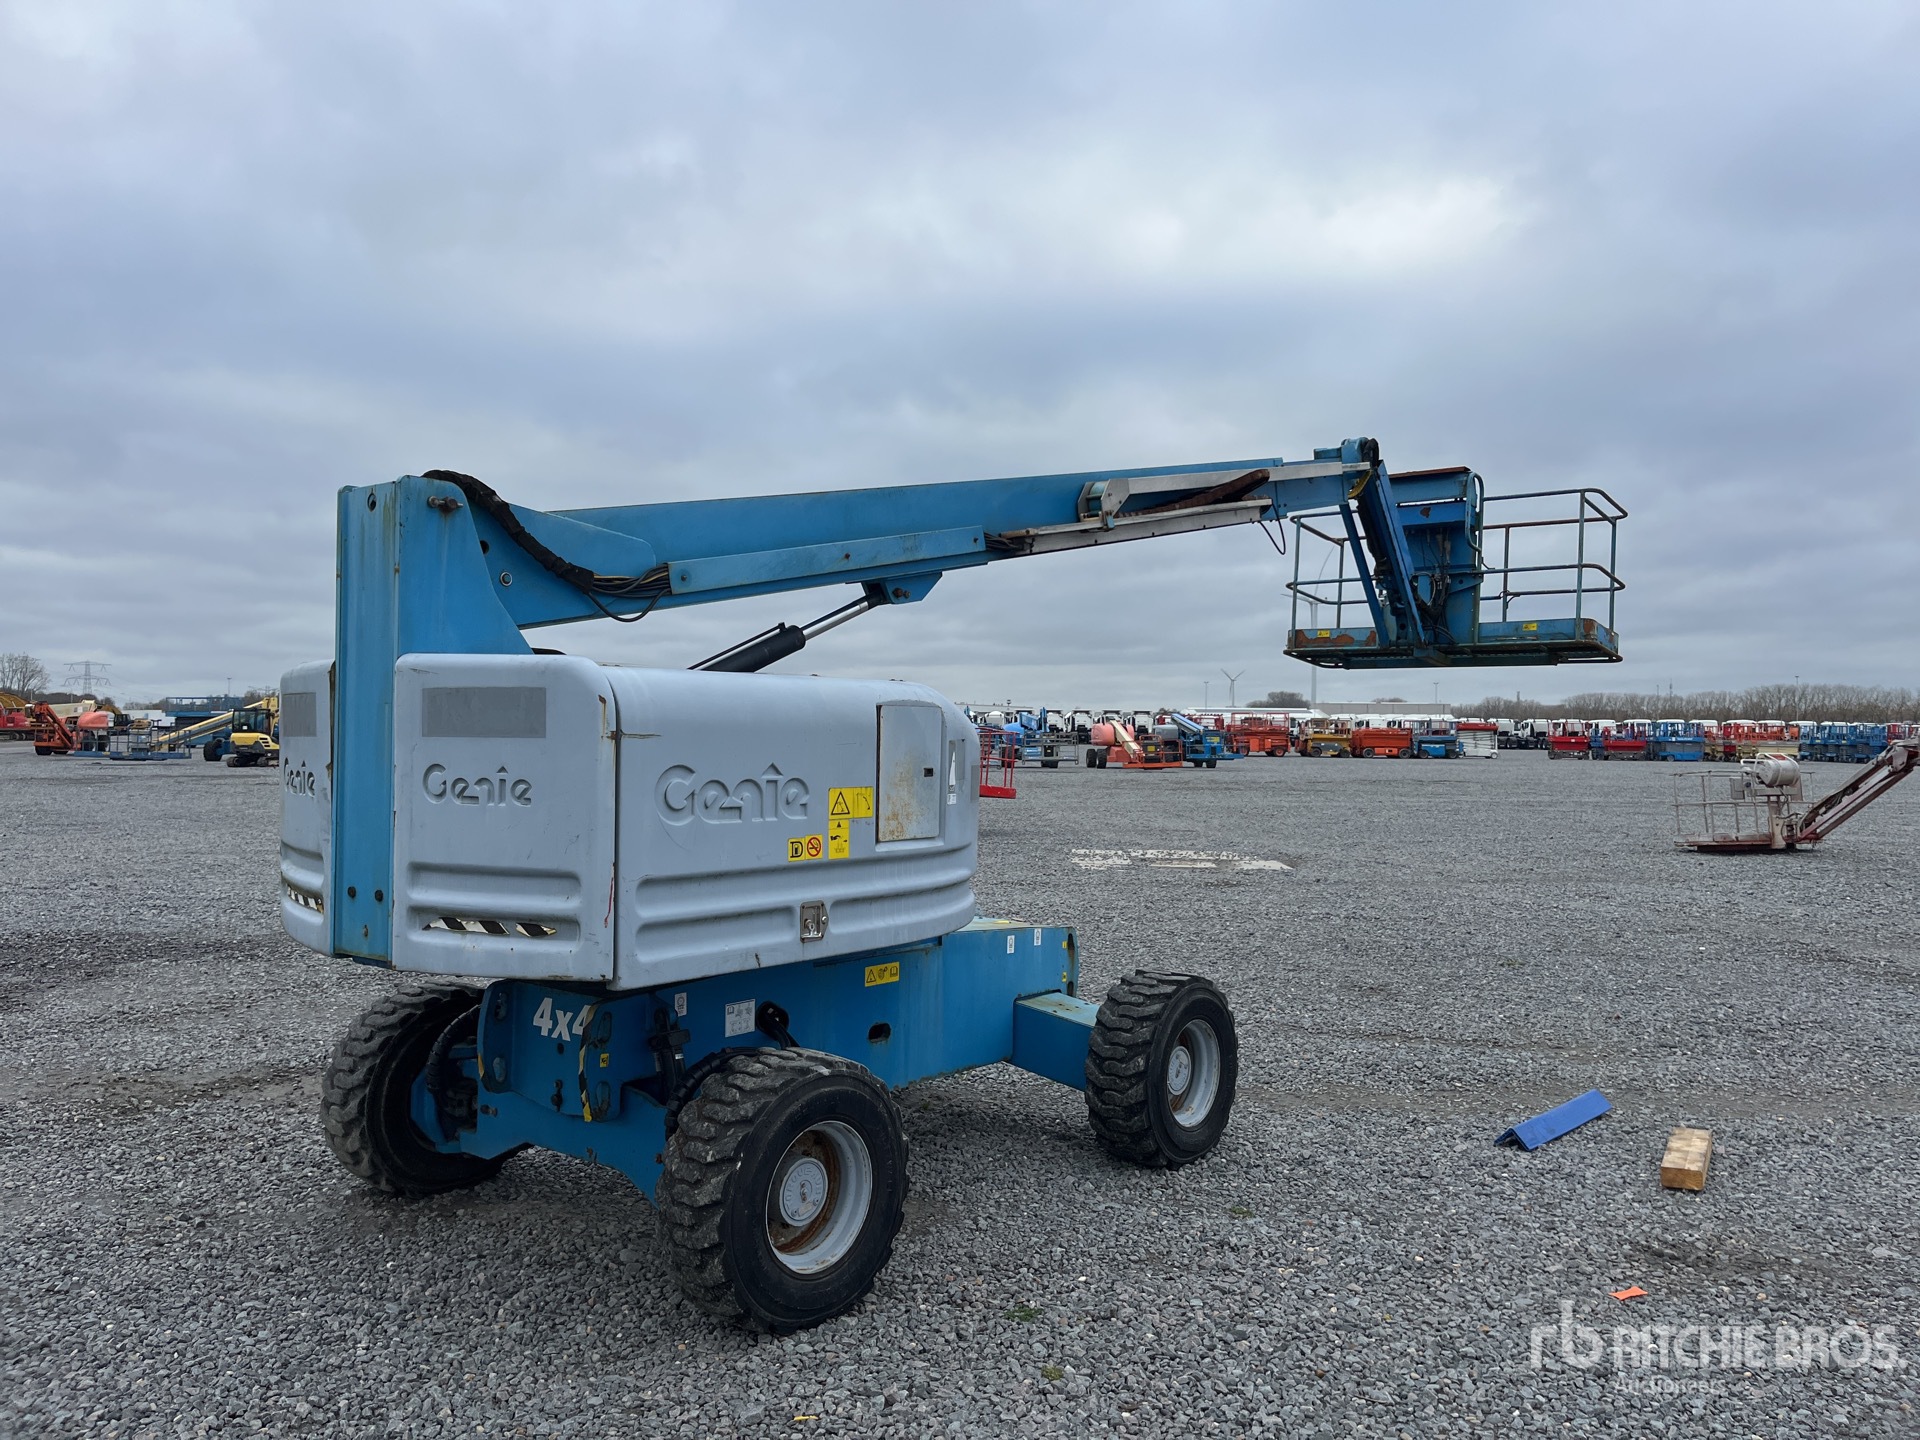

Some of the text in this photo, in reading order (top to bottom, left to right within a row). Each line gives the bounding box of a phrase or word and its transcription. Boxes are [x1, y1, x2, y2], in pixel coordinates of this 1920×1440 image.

[283, 757, 315, 797] Genie
[422, 763, 533, 807] Genie
[655, 762, 810, 826] Genie
[533, 997, 591, 1041] 4x4
